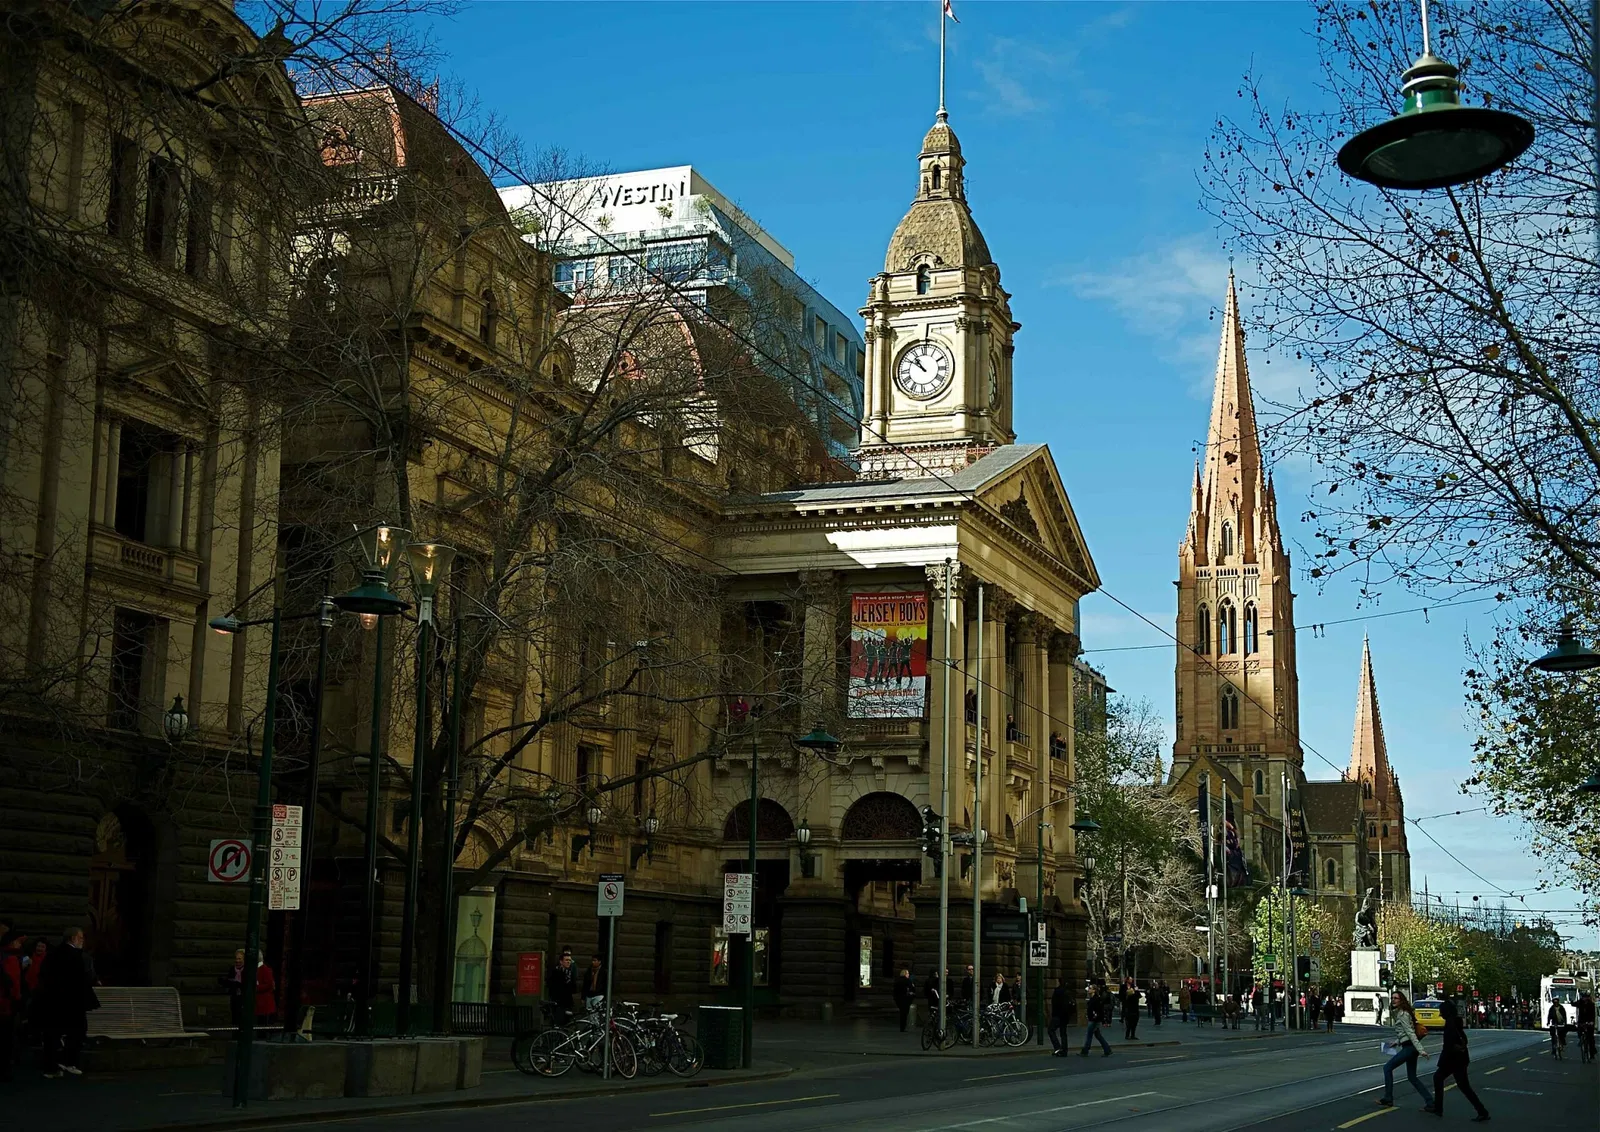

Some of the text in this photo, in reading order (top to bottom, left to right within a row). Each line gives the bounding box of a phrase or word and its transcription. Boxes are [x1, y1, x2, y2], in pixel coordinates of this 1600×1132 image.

[597, 181, 684, 208] WESTIN
[854, 601, 926, 622] JERSEY BOYS
